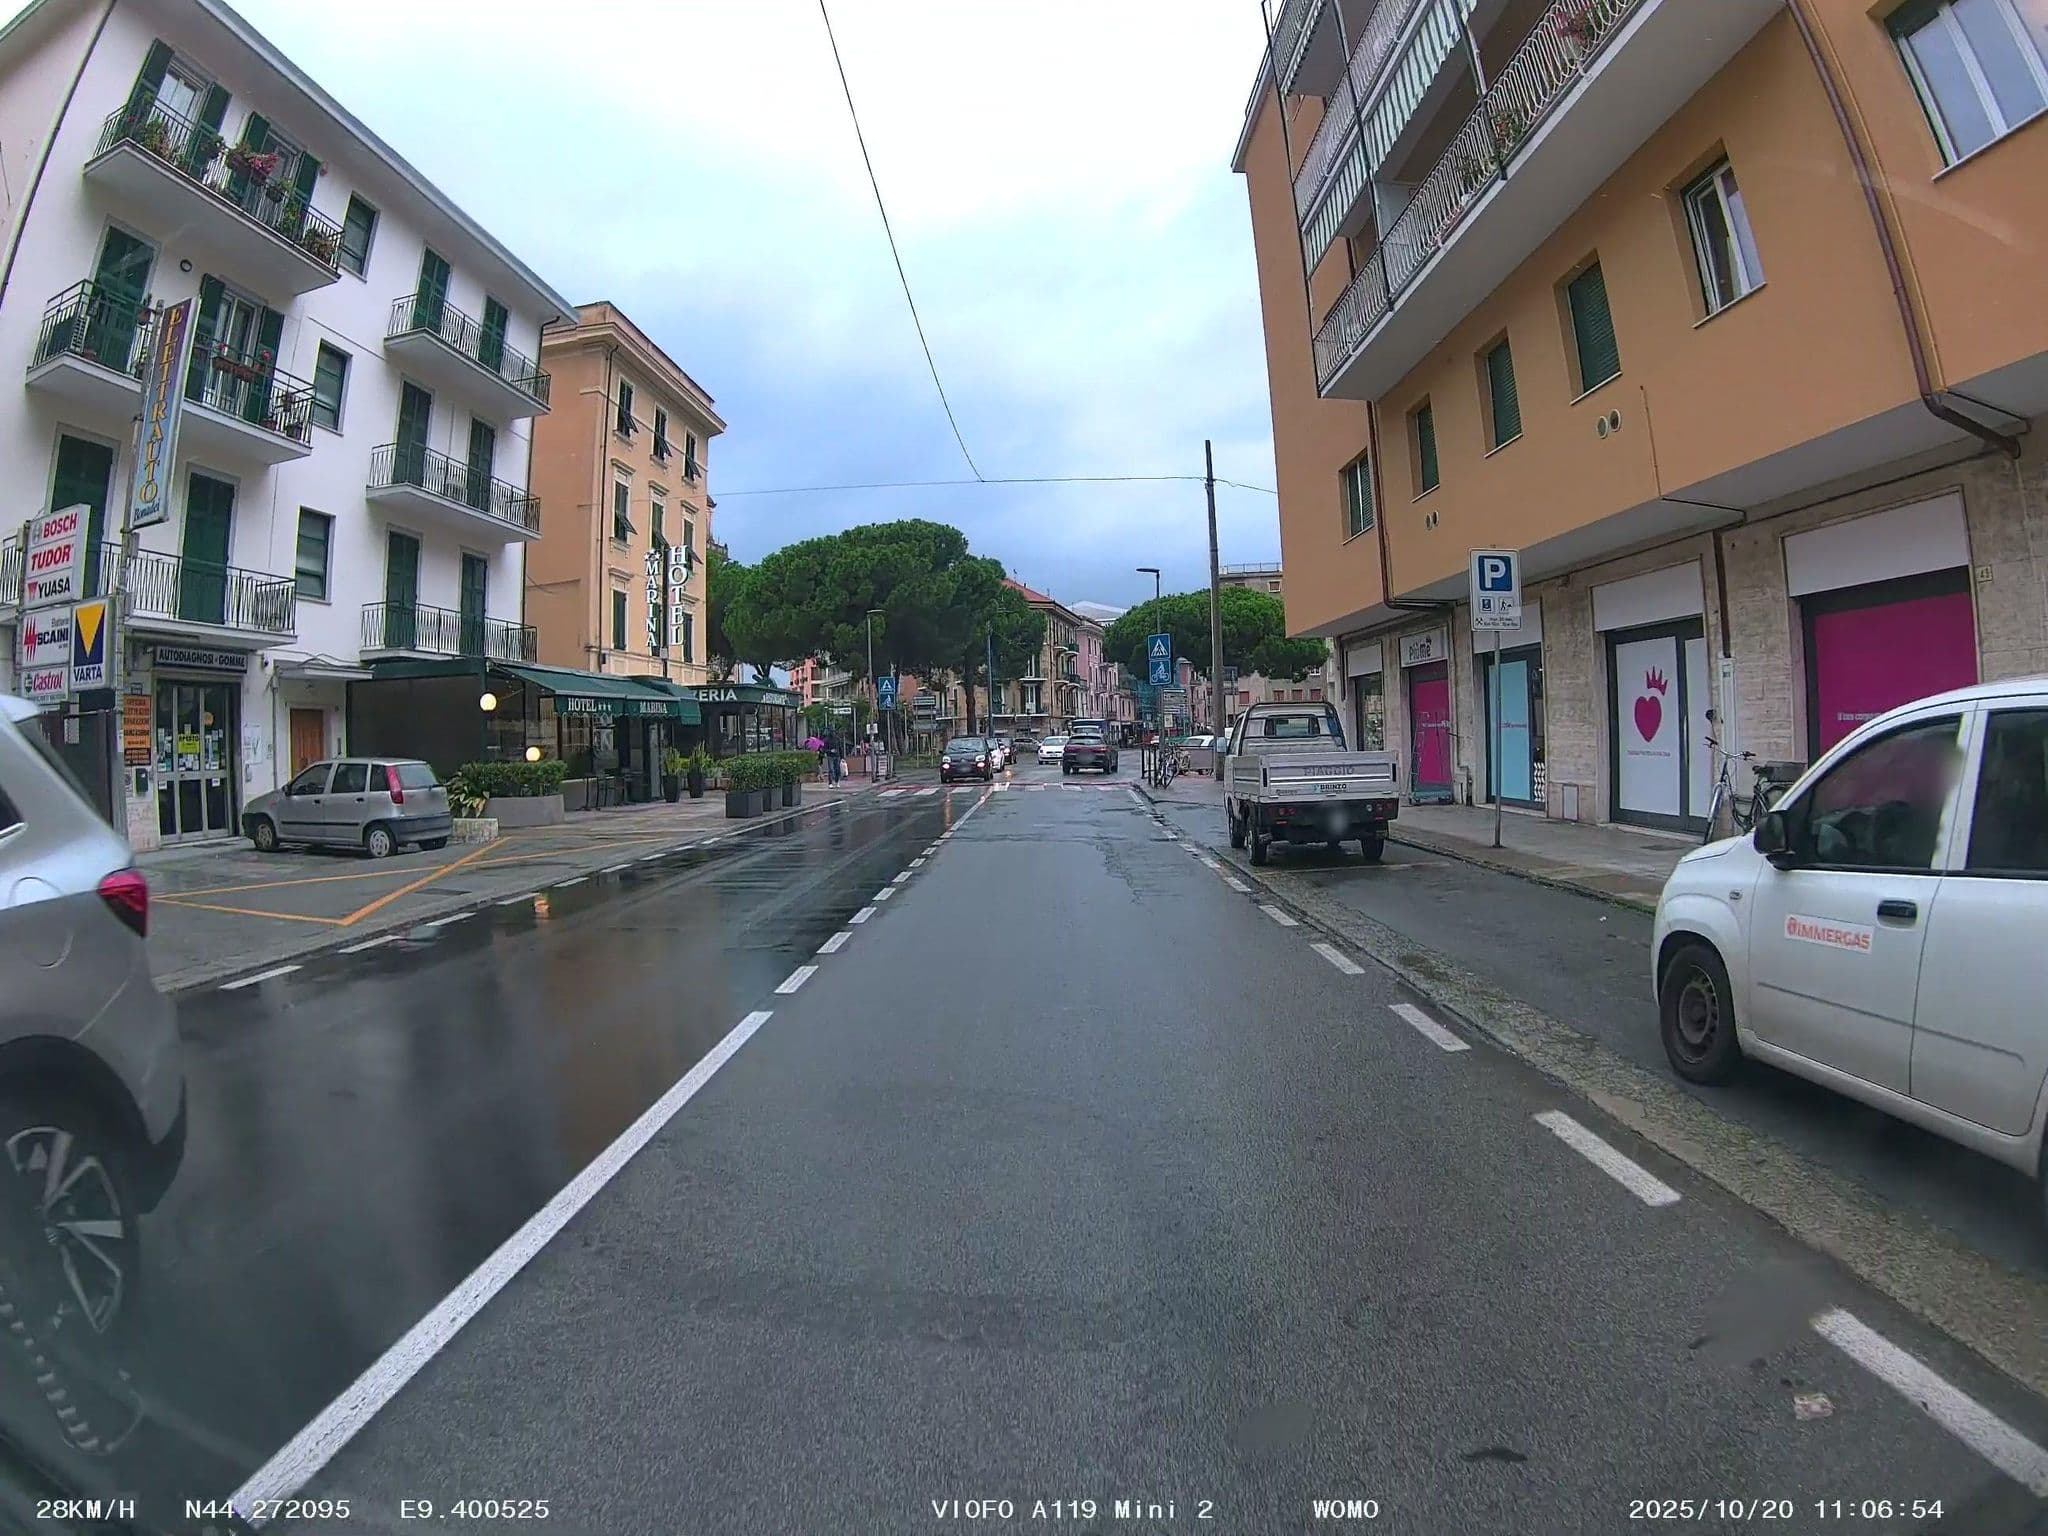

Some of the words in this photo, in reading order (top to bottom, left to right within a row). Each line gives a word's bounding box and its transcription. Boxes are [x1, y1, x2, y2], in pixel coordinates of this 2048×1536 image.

[140, 305, 183, 503] ELETTRAUTO
[43, 512, 78, 539] BOSCH
[31, 544, 72, 572] TUDOR
[1484, 558, 1506, 589] P
[38, 576, 71, 599] YUASA
[669, 544, 688, 646] HOTEL
[645, 560, 660, 647] MARINA
[37, 627, 69, 646] SCAINI
[159, 648, 214, 665] AUTODIAGNOSI
[33, 671, 64, 692] Castrol
[73, 665, 103, 682] VARTA
[568, 698, 597, 712] HOTEL
[640, 701, 668, 714] MARINA
[1303, 766, 1355, 777] PIAGGIO
[1797, 922, 1871, 950] IMMERGAS
